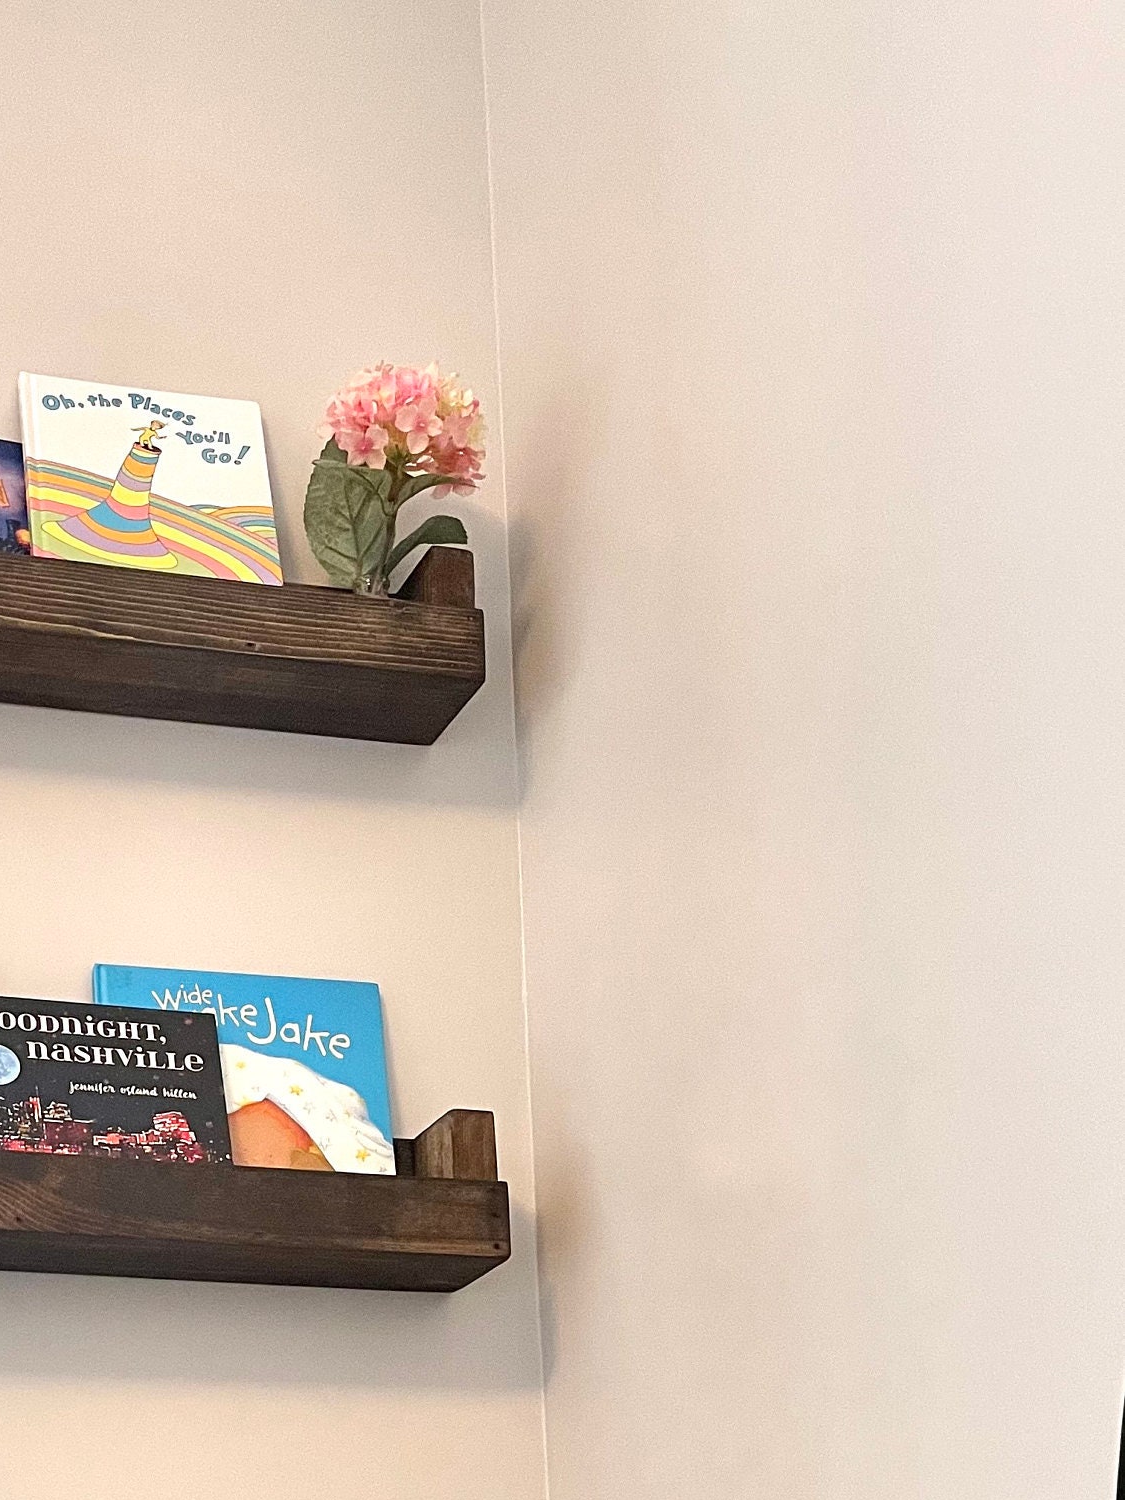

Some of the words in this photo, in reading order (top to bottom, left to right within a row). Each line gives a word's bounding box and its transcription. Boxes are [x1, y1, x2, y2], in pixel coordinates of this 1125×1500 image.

[42, 395, 84, 410] Oh,
[87, 392, 123, 409] the
[128, 393, 197, 426] Places
[175, 430, 231, 446] You'll
[201, 445, 251, 466] Go!
[151, 983, 213, 1011] Wide
[247, 997, 352, 1060] Jake
